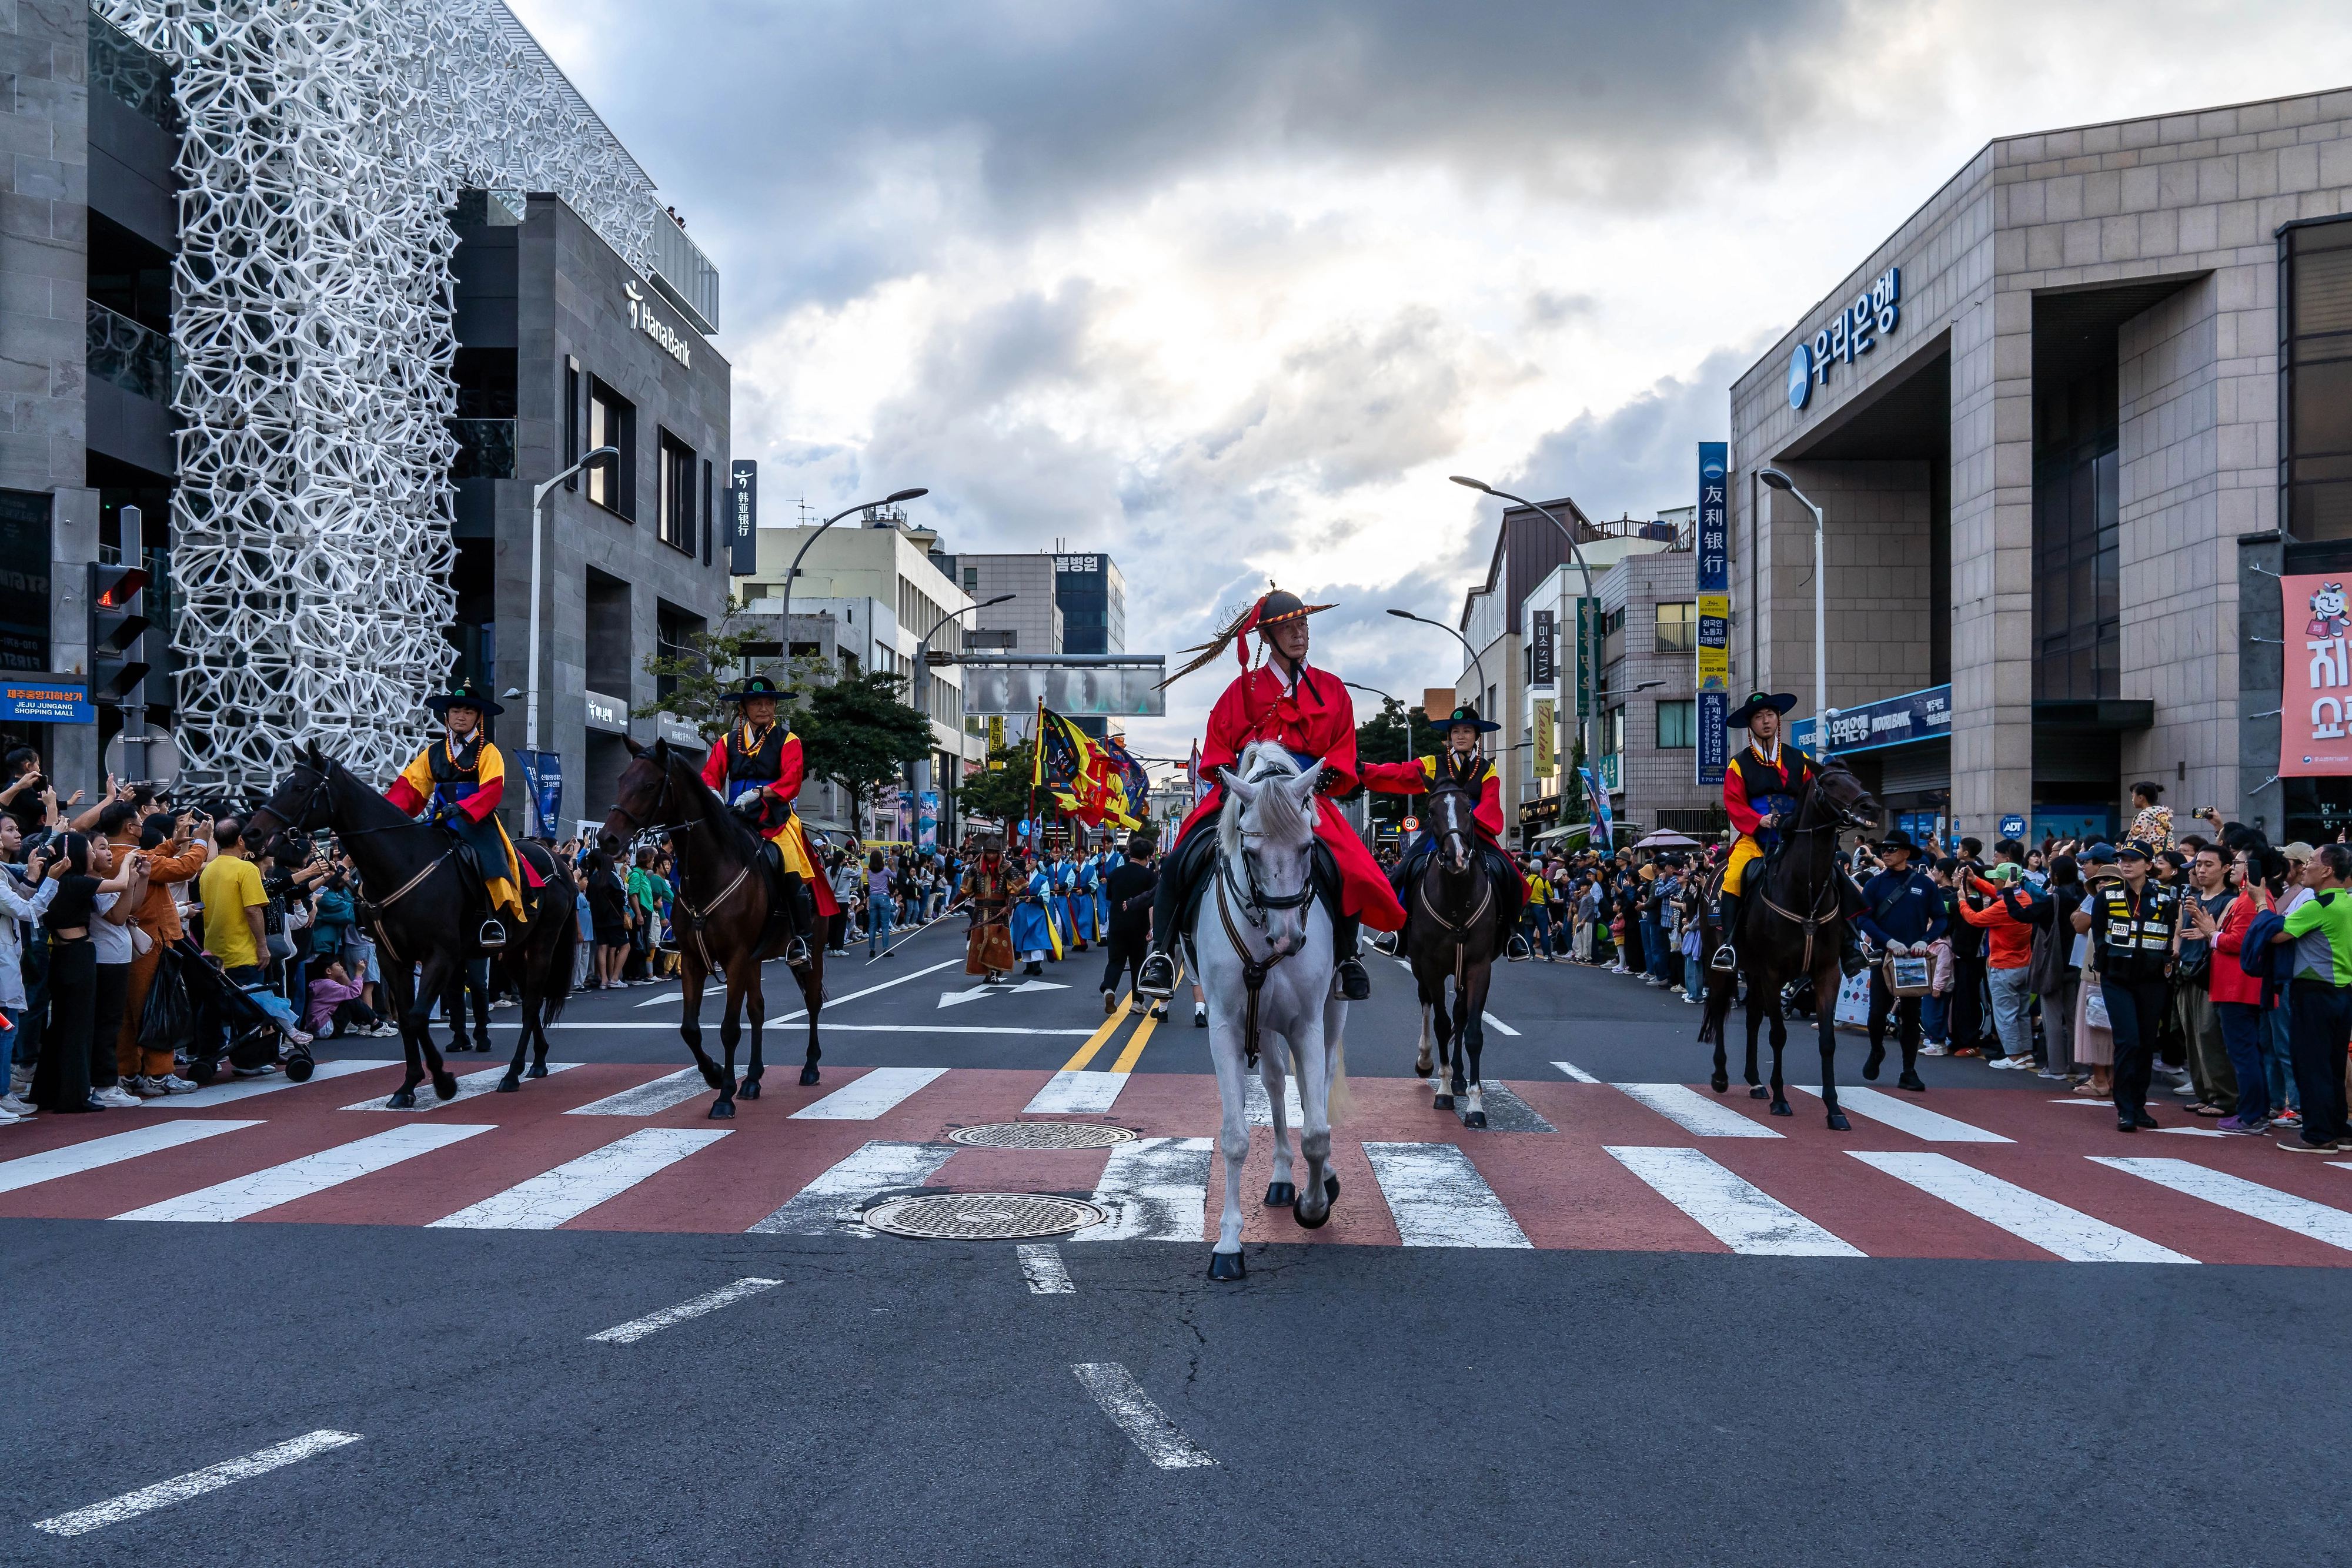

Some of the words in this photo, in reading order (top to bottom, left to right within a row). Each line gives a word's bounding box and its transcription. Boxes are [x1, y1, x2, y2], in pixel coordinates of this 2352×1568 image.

[640, 302, 667, 349] Hana
[668, 326, 690, 370] Bank
[1812, 268, 1899, 385] 우리은행
[737, 492, 749, 536] 韩亚银行
[1704, 485, 1723, 573] 友利银行
[1055, 556, 1098, 572] 봄병원
[1538, 626, 1548, 646] 미소
[1538, 650, 1548, 680] STAY
[7, 689, 83, 701] 제주중앙지하상가
[595, 705, 613, 723] 하나은행
[1872, 714, 1893, 733] WOORI
[1892, 710, 1911, 728] BANK
[1711, 707, 1722, 764] 제주이주민센터
[1832, 714, 1870, 745] 우리은행
[2004, 822, 2022, 831] ADT
